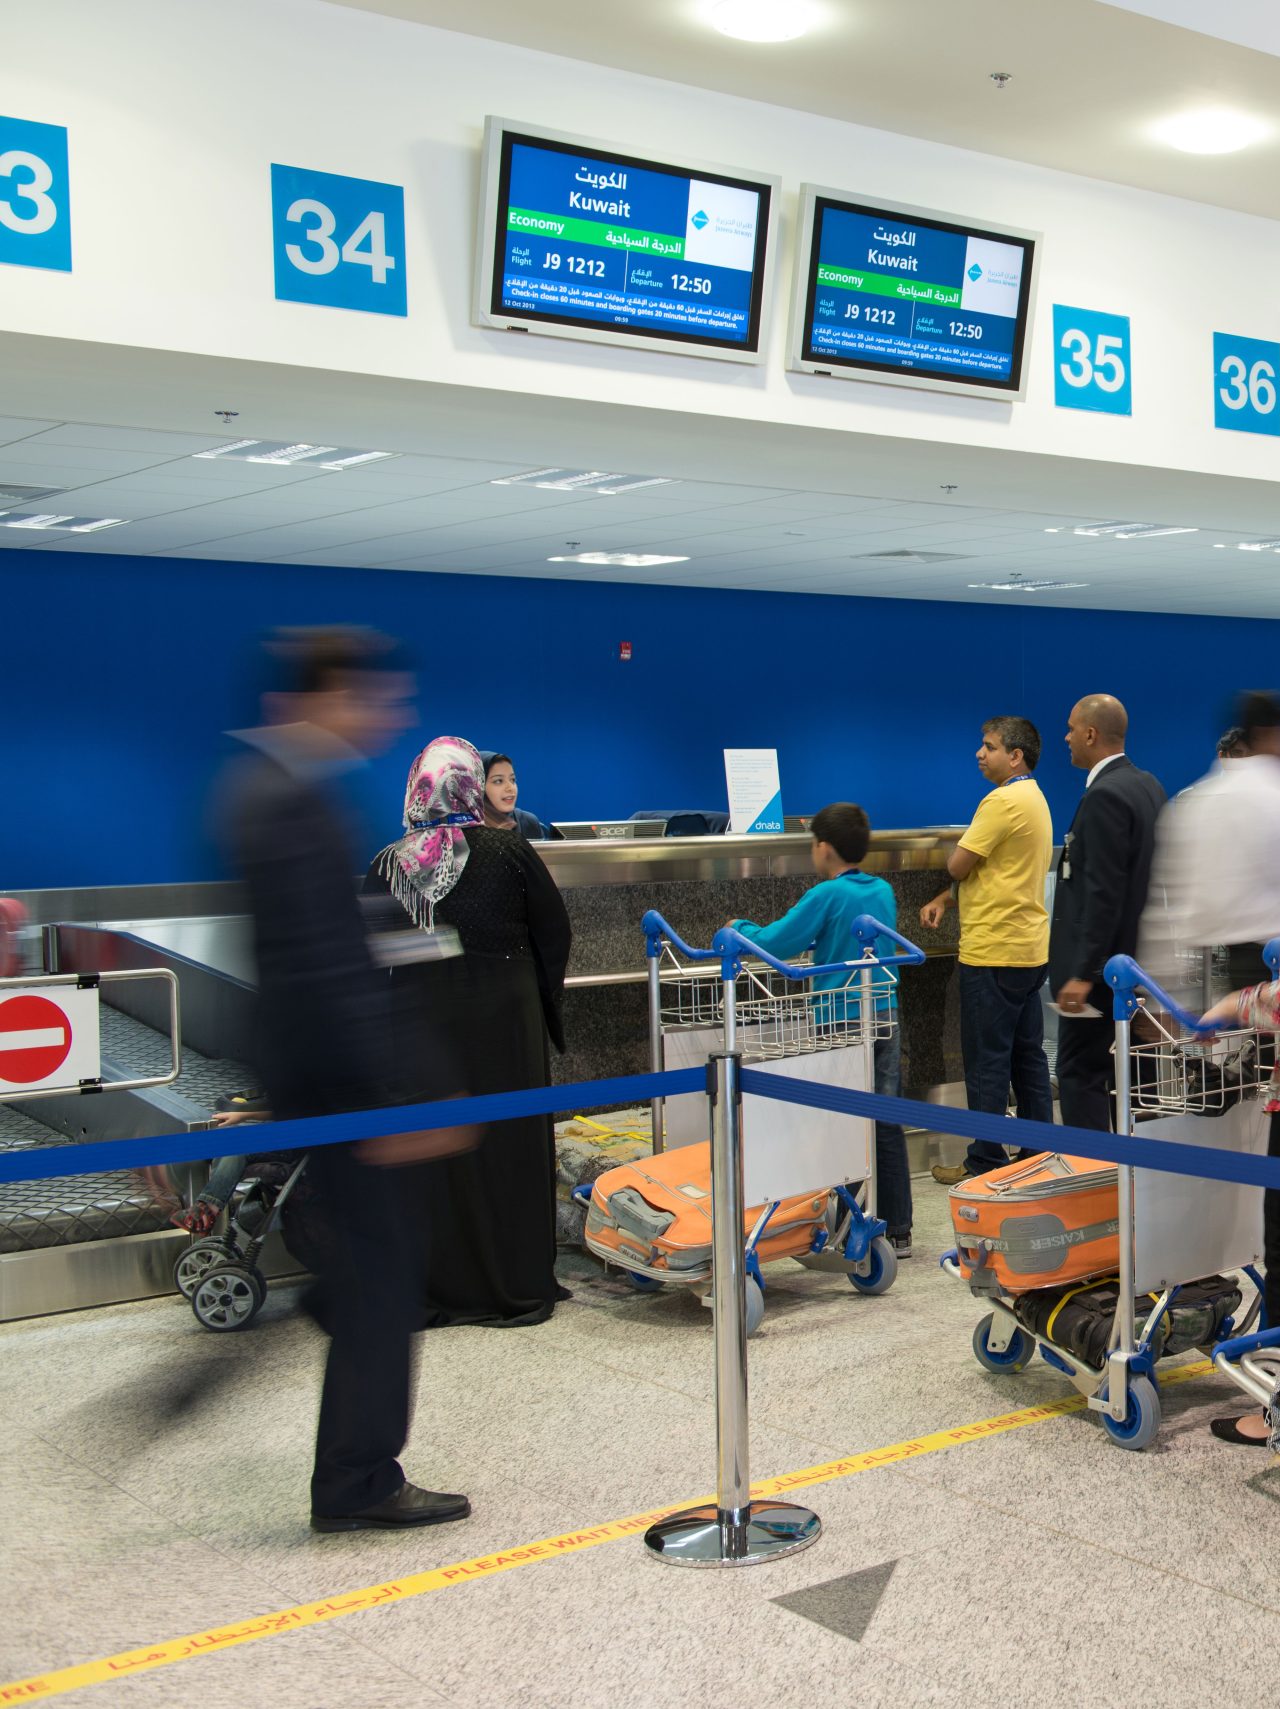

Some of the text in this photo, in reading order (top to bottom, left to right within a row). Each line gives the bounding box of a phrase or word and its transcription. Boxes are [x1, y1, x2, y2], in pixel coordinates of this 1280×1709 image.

[575, 166, 627, 190] الكويت
[569, 191, 630, 218] Kuwait
[508, 212, 565, 234] Economy
[285, 198, 395, 284] 34
[604, 231, 682, 254] الدرجة السياحية
[873, 226, 916, 247] الكويت
[511, 256, 532, 266] Flight
[543, 253, 605, 278] J9 1212
[867, 249, 918, 272] Kuwait
[630, 276, 663, 288] Departure
[671, 274, 712, 295] 12:50
[818, 268, 864, 288] Economy
[896, 282, 959, 303] الدرجة السياحية
[511, 300, 521, 308] Oct
[511, 288, 538, 299] Check-in
[540, 292, 559, 302] closes
[569, 296, 594, 307] minutes
[595, 300, 608, 308] and
[608, 301, 635, 314] boarding
[637, 308, 653, 317] gates
[663, 311, 687, 321] minutes
[688, 315, 707, 324] before
[819, 307, 836, 317] Flight
[844, 303, 896, 326] J9 1212
[915, 324, 942, 335] Departure
[949, 321, 983, 340] 12:50
[818, 336, 841, 345] Check-in
[865, 343, 886, 352] minutes
[942, 355, 962, 364] minutes
[1060, 328, 1125, 393] 35
[1220, 355, 1277, 415] 36
[600, 827, 628, 836] acer
[755, 821, 780, 830] dnata
[1030, 1230, 1085, 1250] KAISER
[947, 1414, 1023, 1439] PLEASE
[1024, 1402, 1071, 1418] WAIT
[863, 1442, 925, 1465] الرجاء
[440, 1546, 551, 1580] PLEASE
[547, 1527, 613, 1550] WAIT
[313, 1586, 402, 1617] الرجاء
[107, 1652, 167, 1671] هنا
